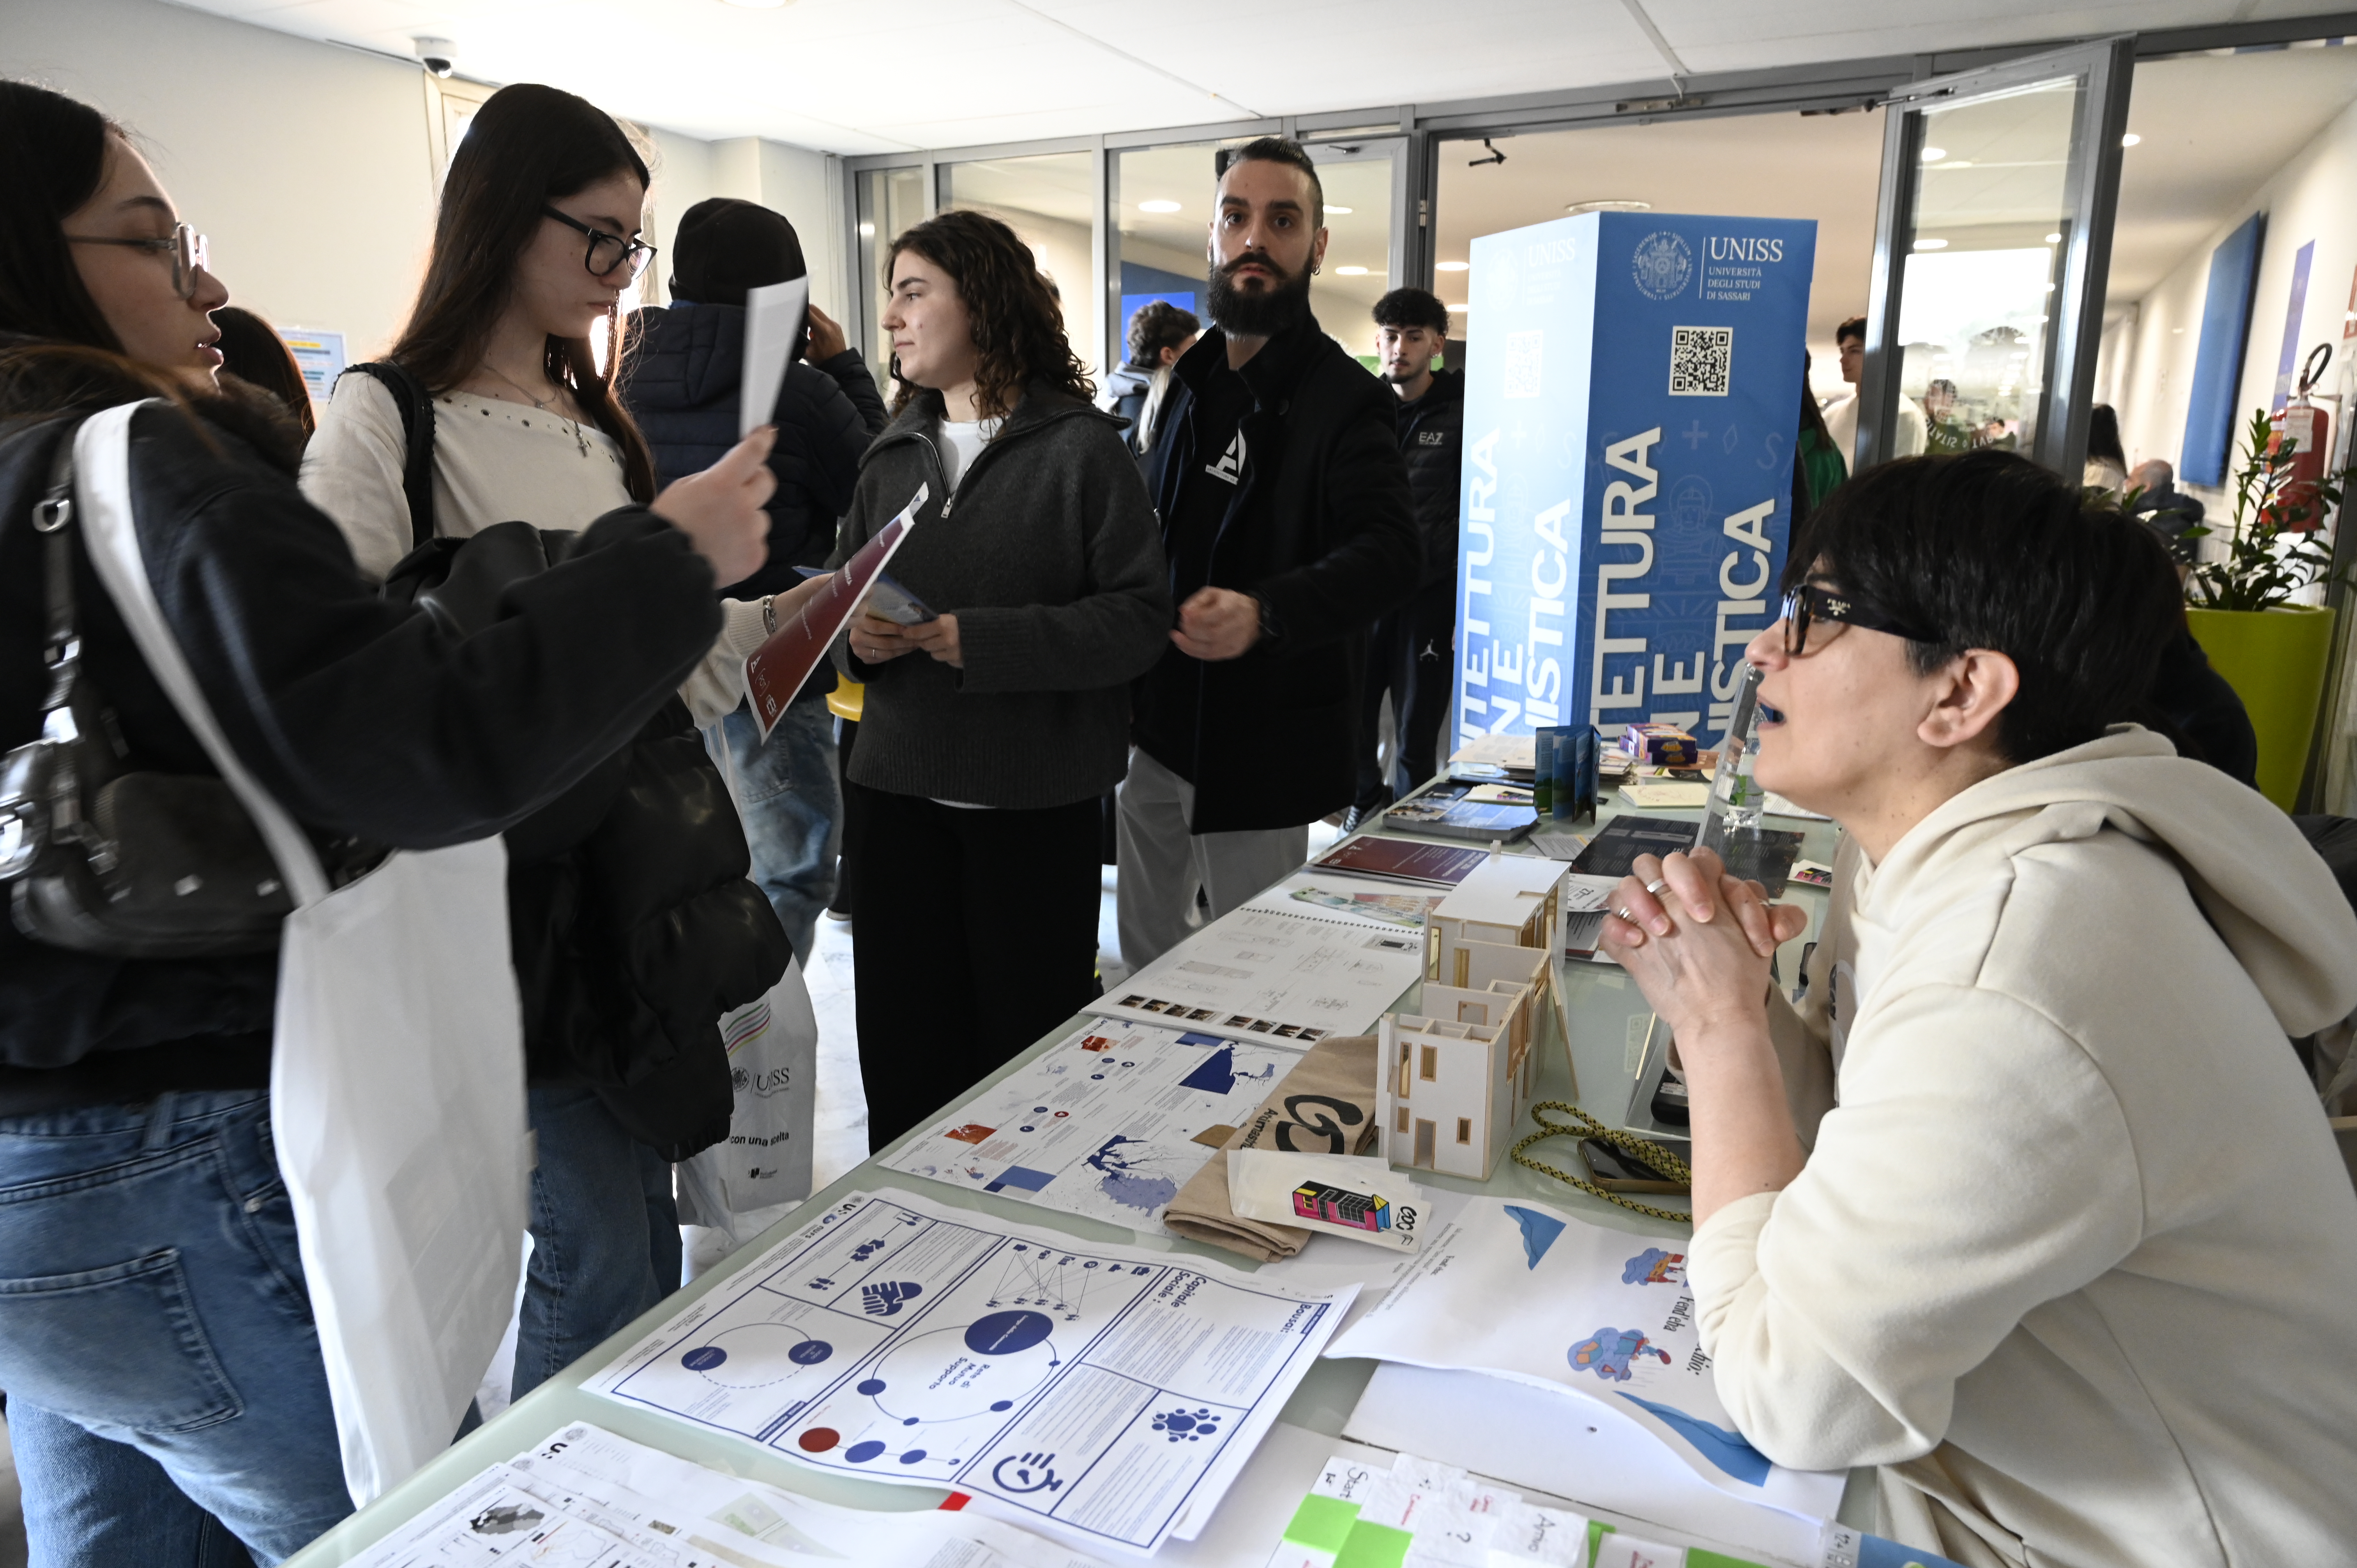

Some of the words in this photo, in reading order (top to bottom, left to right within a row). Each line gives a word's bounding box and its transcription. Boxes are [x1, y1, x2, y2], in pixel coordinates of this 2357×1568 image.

[1528, 238, 1576, 267] UNISS
[1710, 237, 1783, 262] UNISS
[1708, 279, 1733, 289] DEGLI
[1735, 279, 1760, 289] STUDI
[1709, 267, 1762, 277] UNIVERSITÀ
[1707, 291, 1716, 300] DI
[1717, 291, 1751, 301] SASSARI
[1419, 432, 1444, 445] EA7
[1459, 427, 1500, 748] ITETTURA
[1590, 427, 1661, 738] TETTURA
[1525, 499, 1571, 727] ISTICA
[1708, 499, 1775, 731] ISTICA
[749, 1137, 768, 1147] una
[770, 1131, 790, 1146] scelta
[1158, 1271, 1191, 1299] Sociale
[1171, 1276, 1207, 1309] Capitale
[1280, 1304, 1311, 1334] Bousai:
[929, 1357, 968, 1389] Supporto
[949, 1363, 976, 1385] Mutuo
[970, 1364, 990, 1379] Rete
[1340, 1466, 1369, 1499] Start
